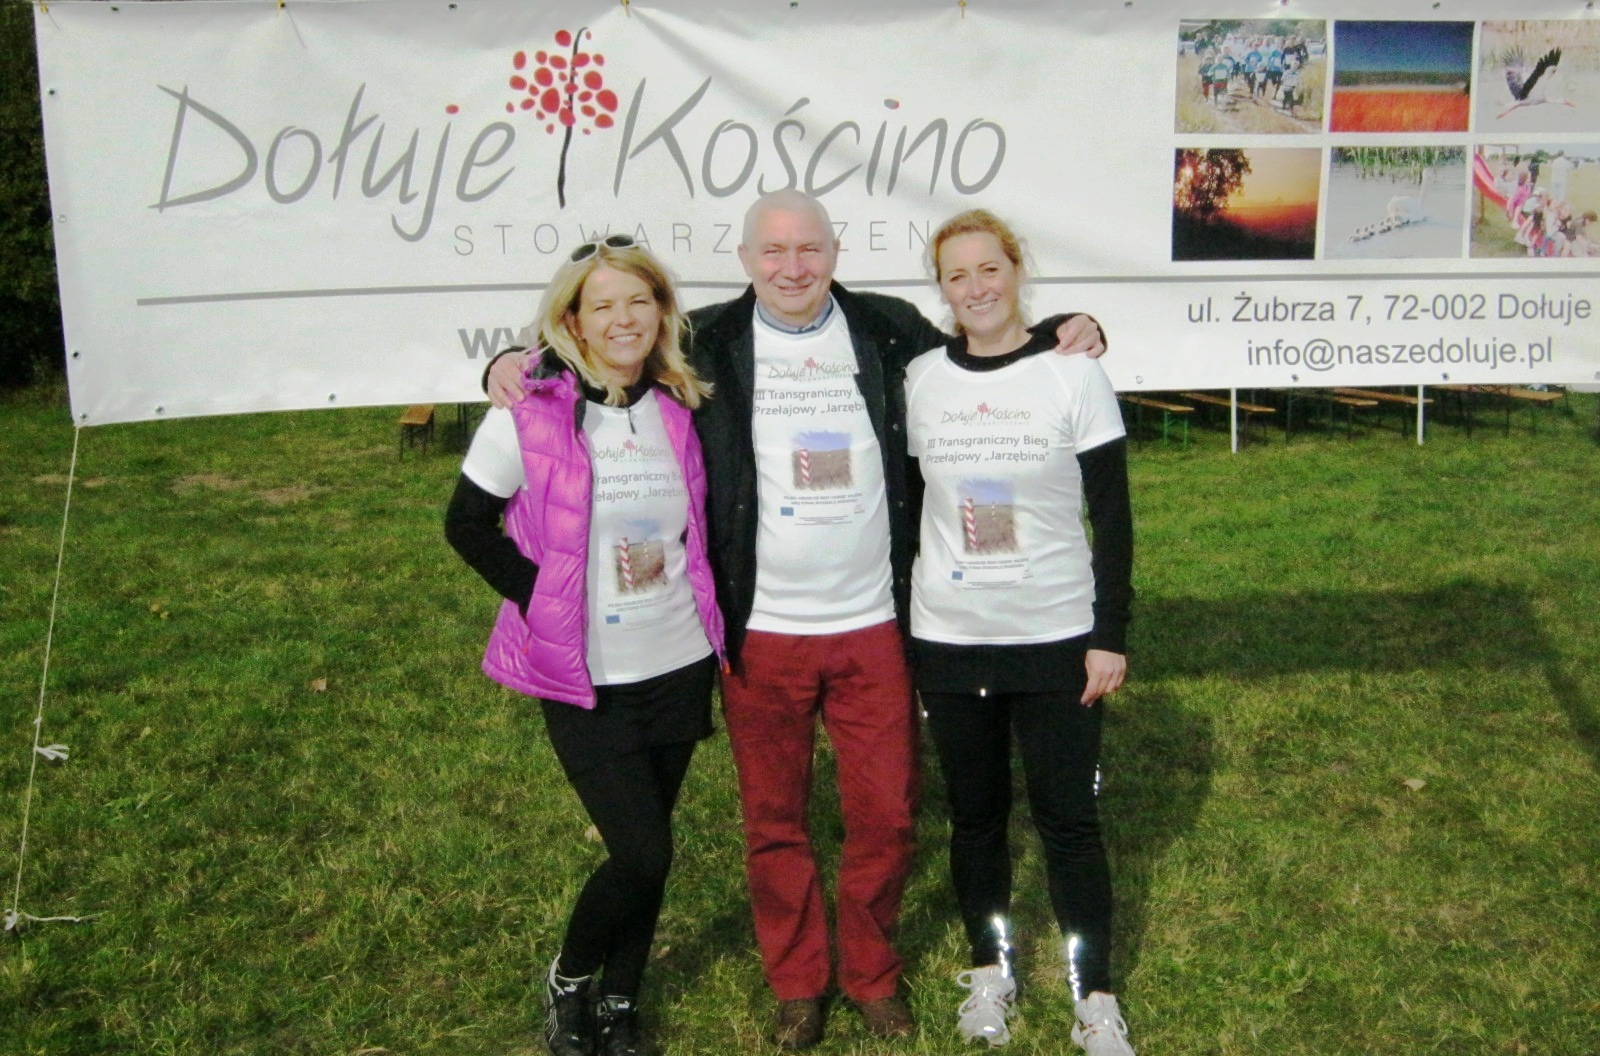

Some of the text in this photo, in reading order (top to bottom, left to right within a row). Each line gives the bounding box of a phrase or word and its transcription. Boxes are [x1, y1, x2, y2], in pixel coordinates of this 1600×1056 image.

[148, 76, 1007, 242] Dołuje Kościno
[453, 221, 931, 256] STOWARZZEN
[1188, 291, 1591, 326] ul. Żubrza 7, 72-002 Dołuje
[1248, 336, 1552, 371] info@naszedoluje.pl
[768, 388, 852, 401] Transgraniczny
[753, 404, 816, 416] Przełajowy
[938, 435, 1020, 448] Transgraniczny
[1023, 435, 1049, 448] Bieg
[926, 452, 981, 464] Przełajowy
[593, 470, 670, 485] ransgraniczny
[595, 489, 639, 503] ełajowy
